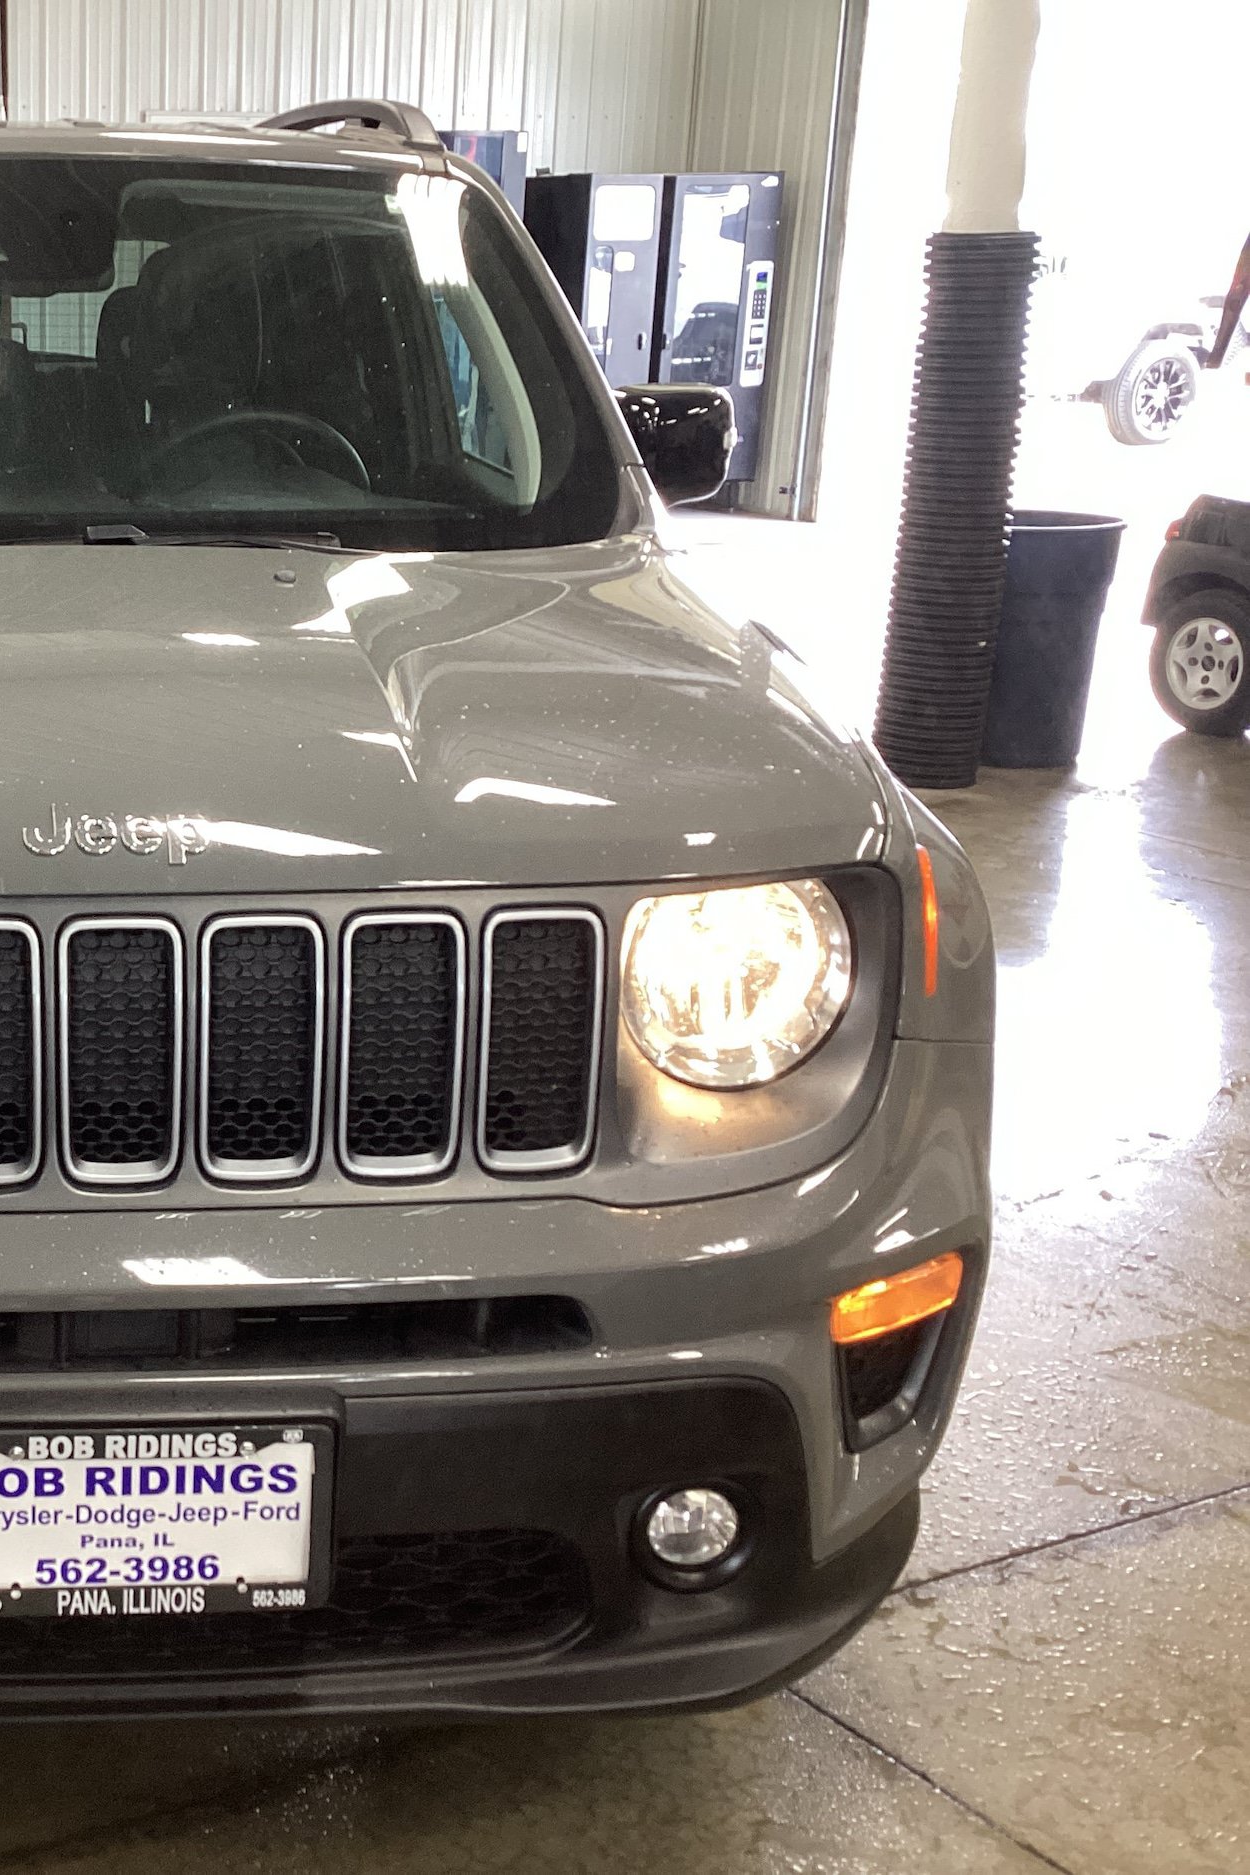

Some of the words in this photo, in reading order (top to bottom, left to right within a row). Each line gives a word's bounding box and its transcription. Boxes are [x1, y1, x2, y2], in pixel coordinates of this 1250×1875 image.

[22, 803, 209, 865] Jeep
[28, 1435, 95, 1460] BOB
[105, 1432, 238, 1460] RIDINGS
[85, 1463, 298, 1497] RIDINGS
[80, 1534, 145, 1550] Pana,
[153, 1532, 175, 1547] IL
[35, 1554, 220, 1585] 562-3986
[123, 1586, 206, 1615] ILLINOIS
